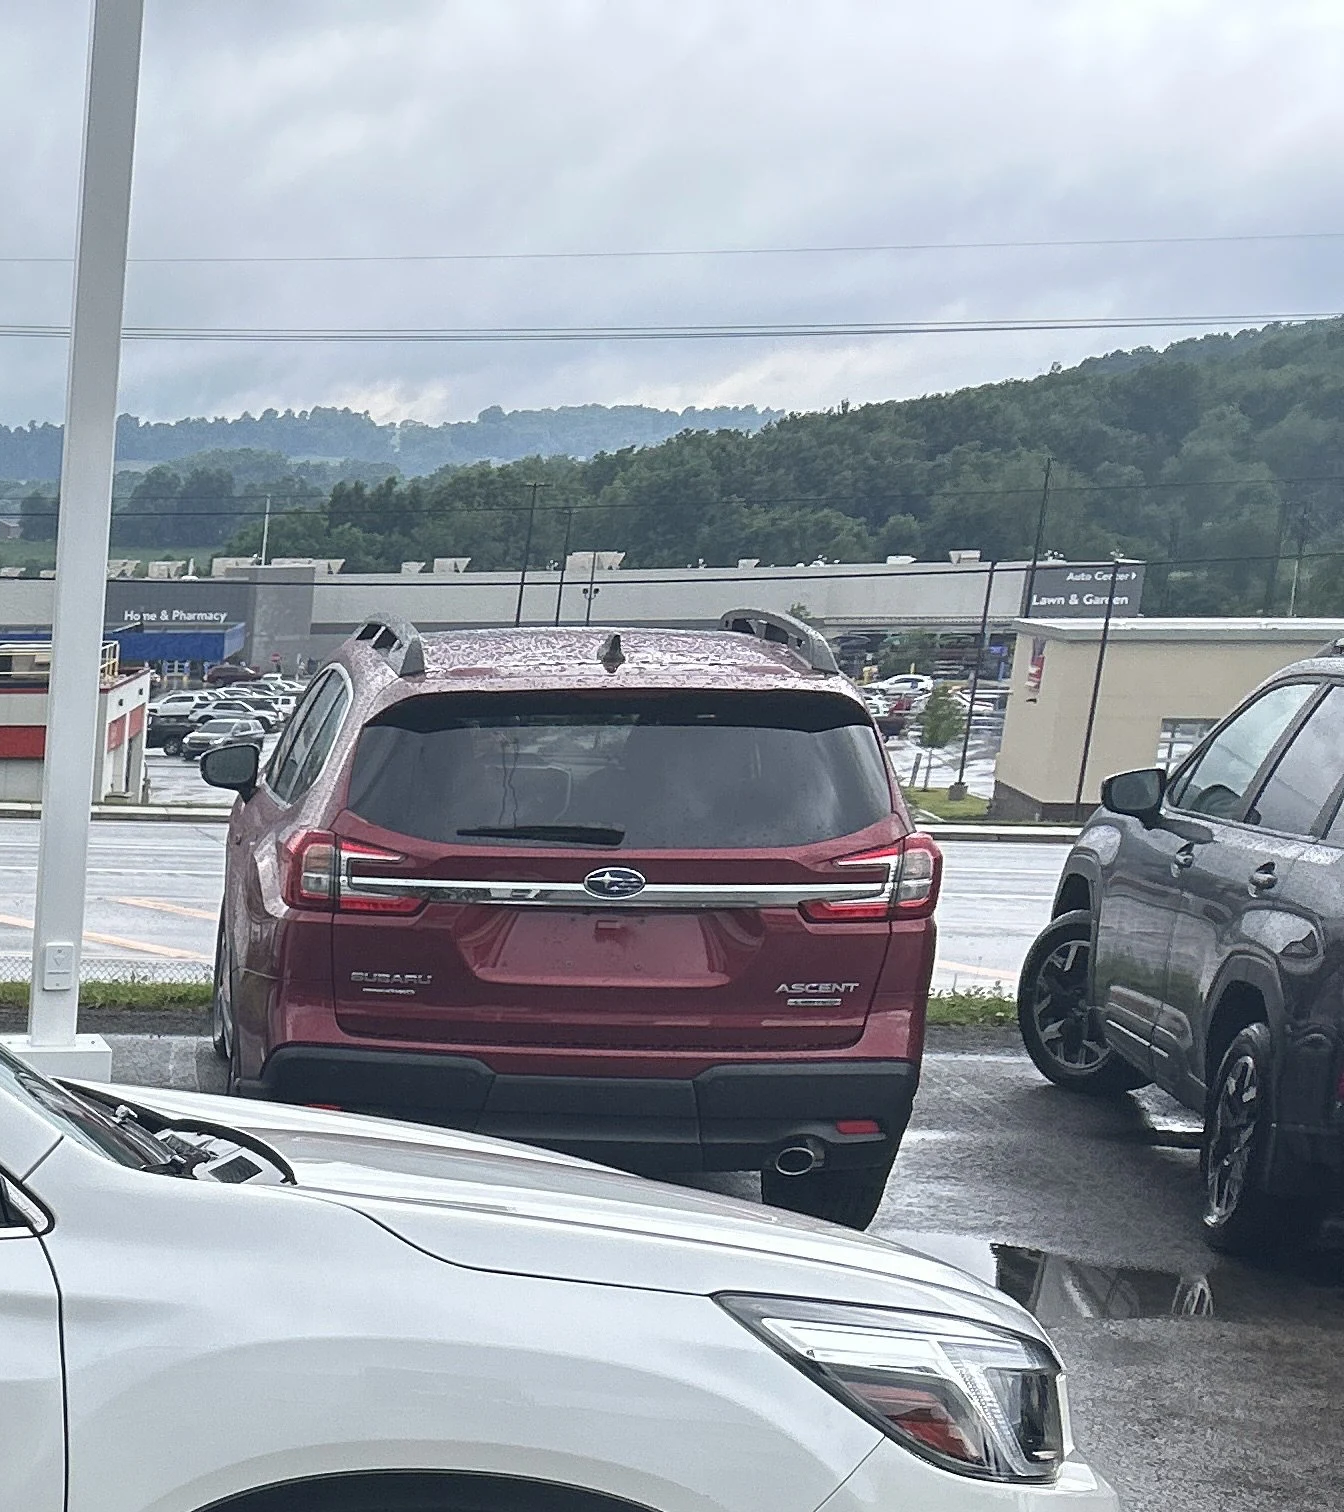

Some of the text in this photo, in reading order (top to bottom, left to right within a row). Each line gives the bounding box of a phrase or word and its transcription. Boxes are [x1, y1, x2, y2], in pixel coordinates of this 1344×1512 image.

[1066, 572, 1092, 581] Auto
[1032, 594, 1065, 606] Lawn
[1068, 594, 1079, 605] &
[160, 610, 169, 621] &
[172, 609, 228, 624] Pharmacy
[350, 971, 433, 985] SUBARU
[774, 982, 860, 994] ASCENT
